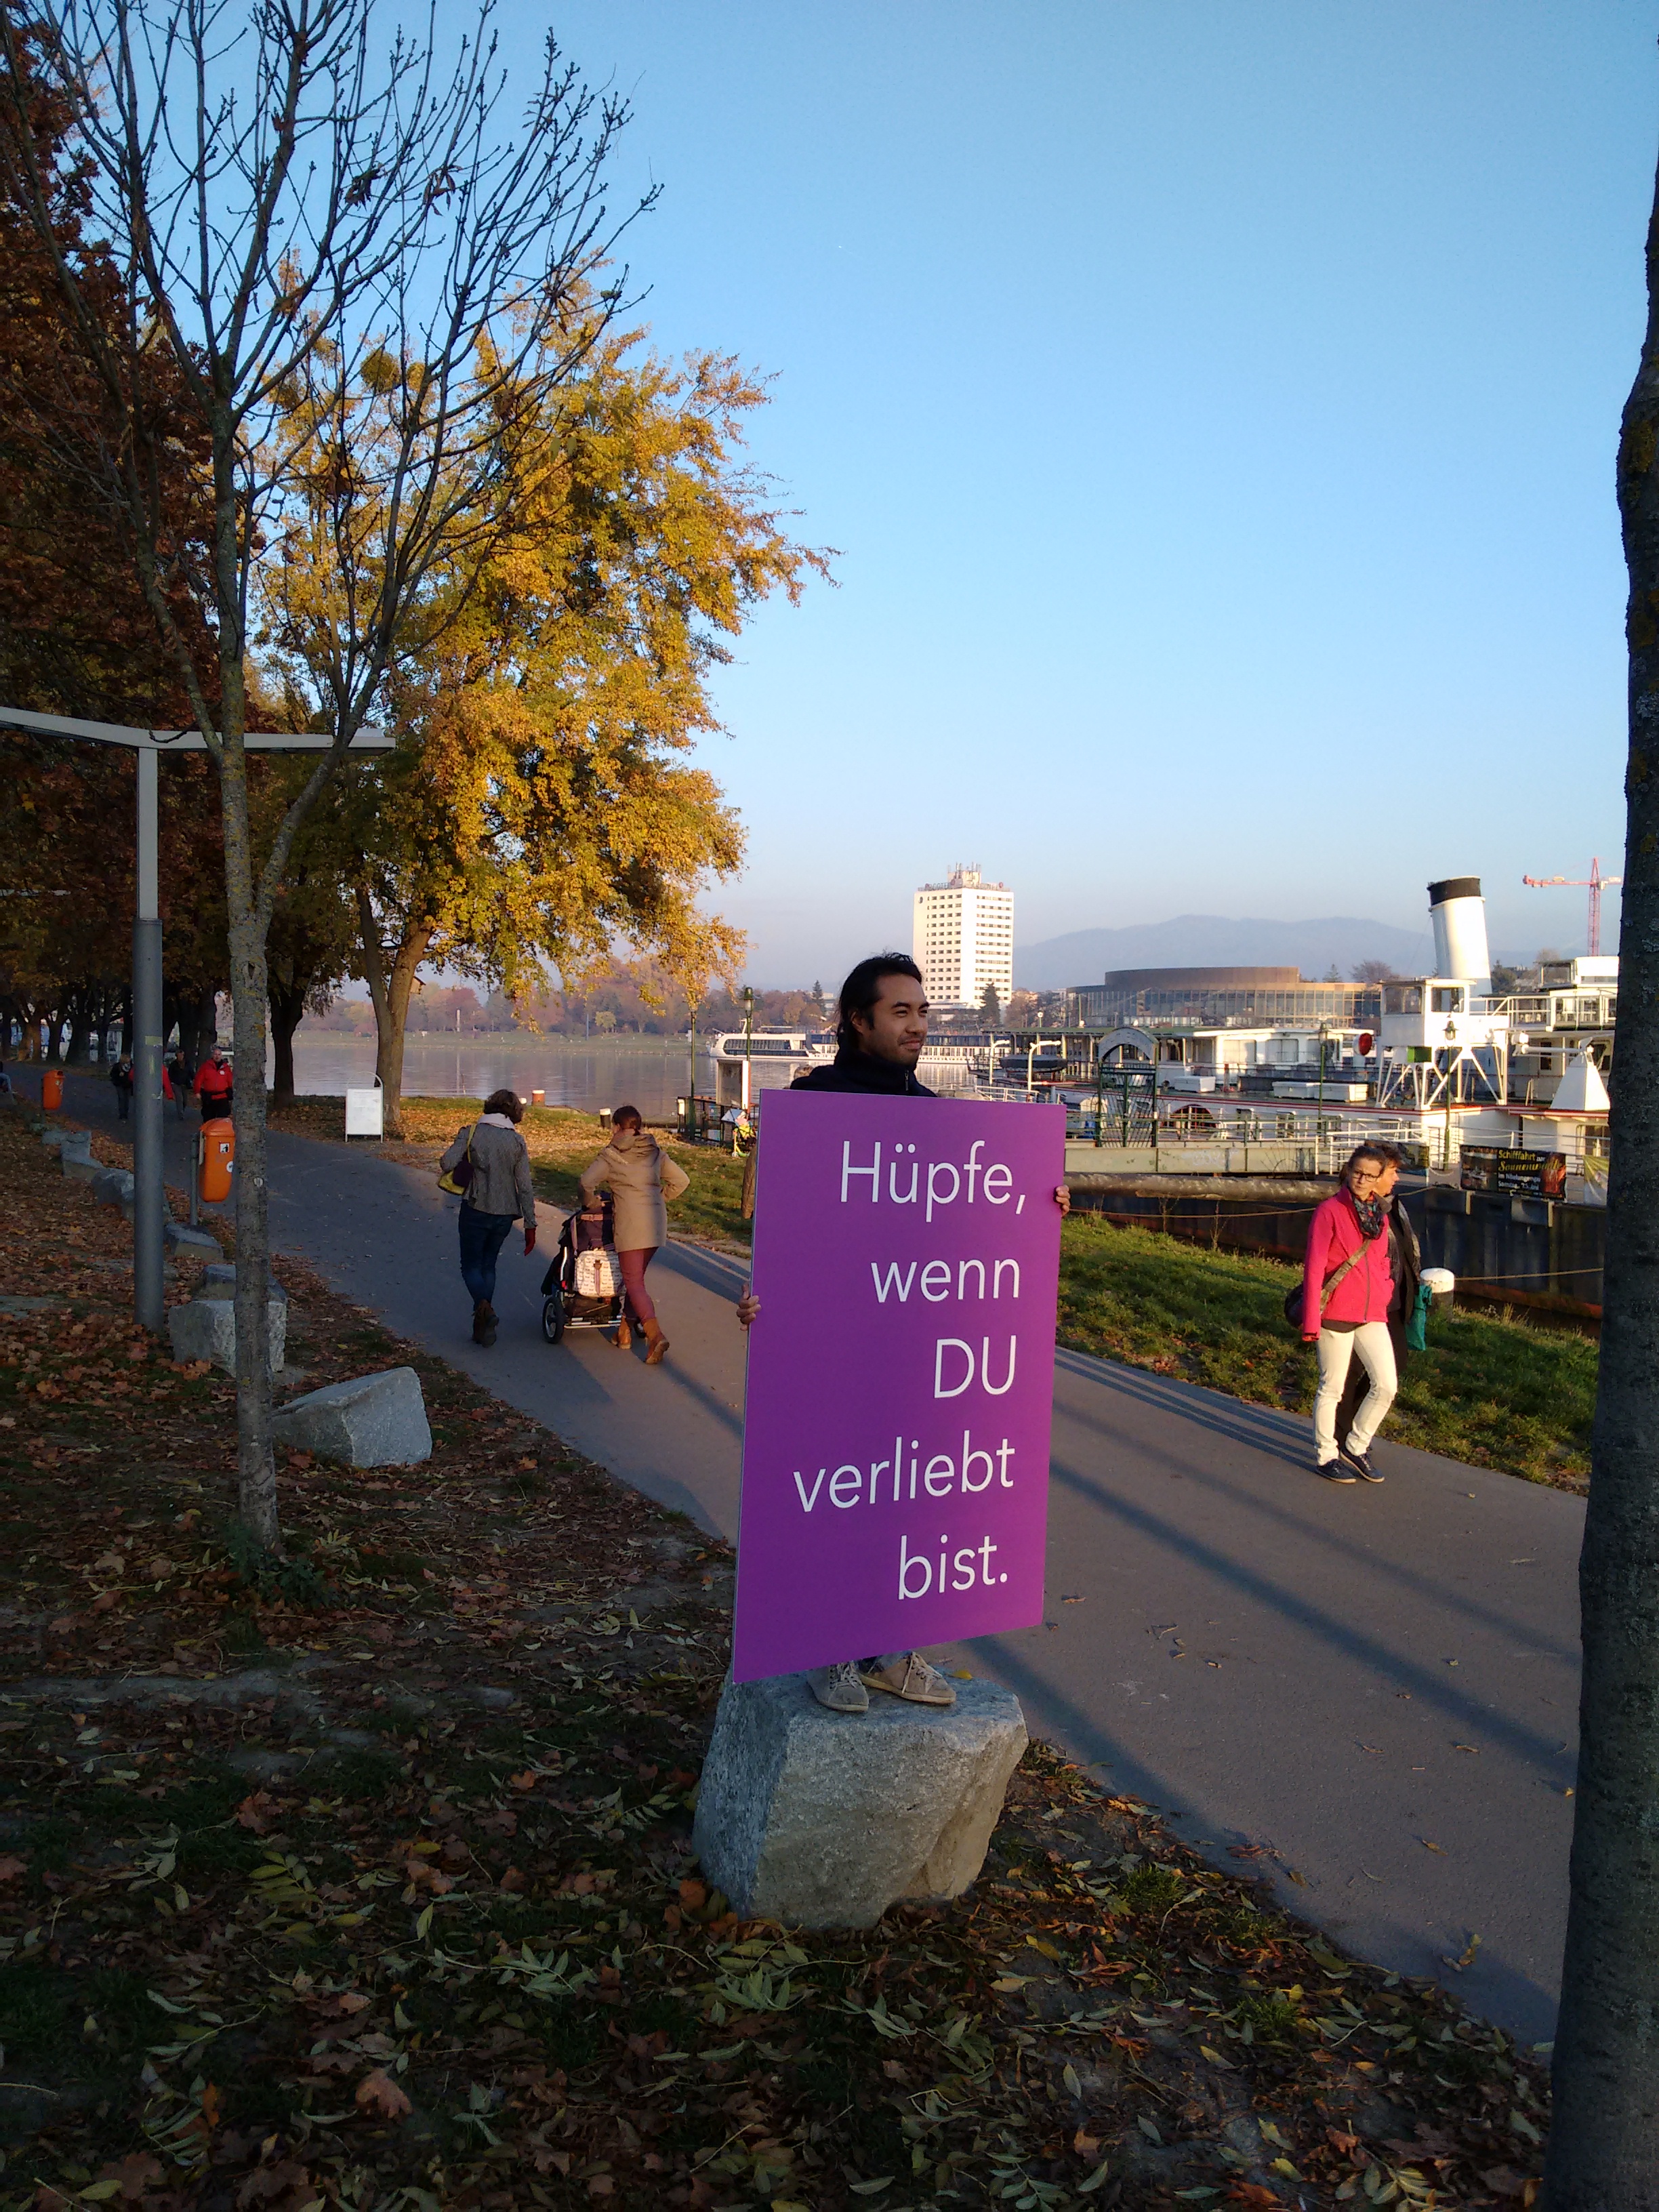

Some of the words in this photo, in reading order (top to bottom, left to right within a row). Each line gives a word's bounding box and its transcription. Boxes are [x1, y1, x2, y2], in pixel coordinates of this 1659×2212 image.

[840, 1140, 1027, 1223] Hüpfe,
[1498, 1149, 1536, 1161] Schifffahrt
[871, 1258, 1020, 1303] wenn
[934, 1334, 1017, 1399] DU
[793, 1429, 1015, 1512] verliebt
[899, 1534, 1008, 1600] bist.
